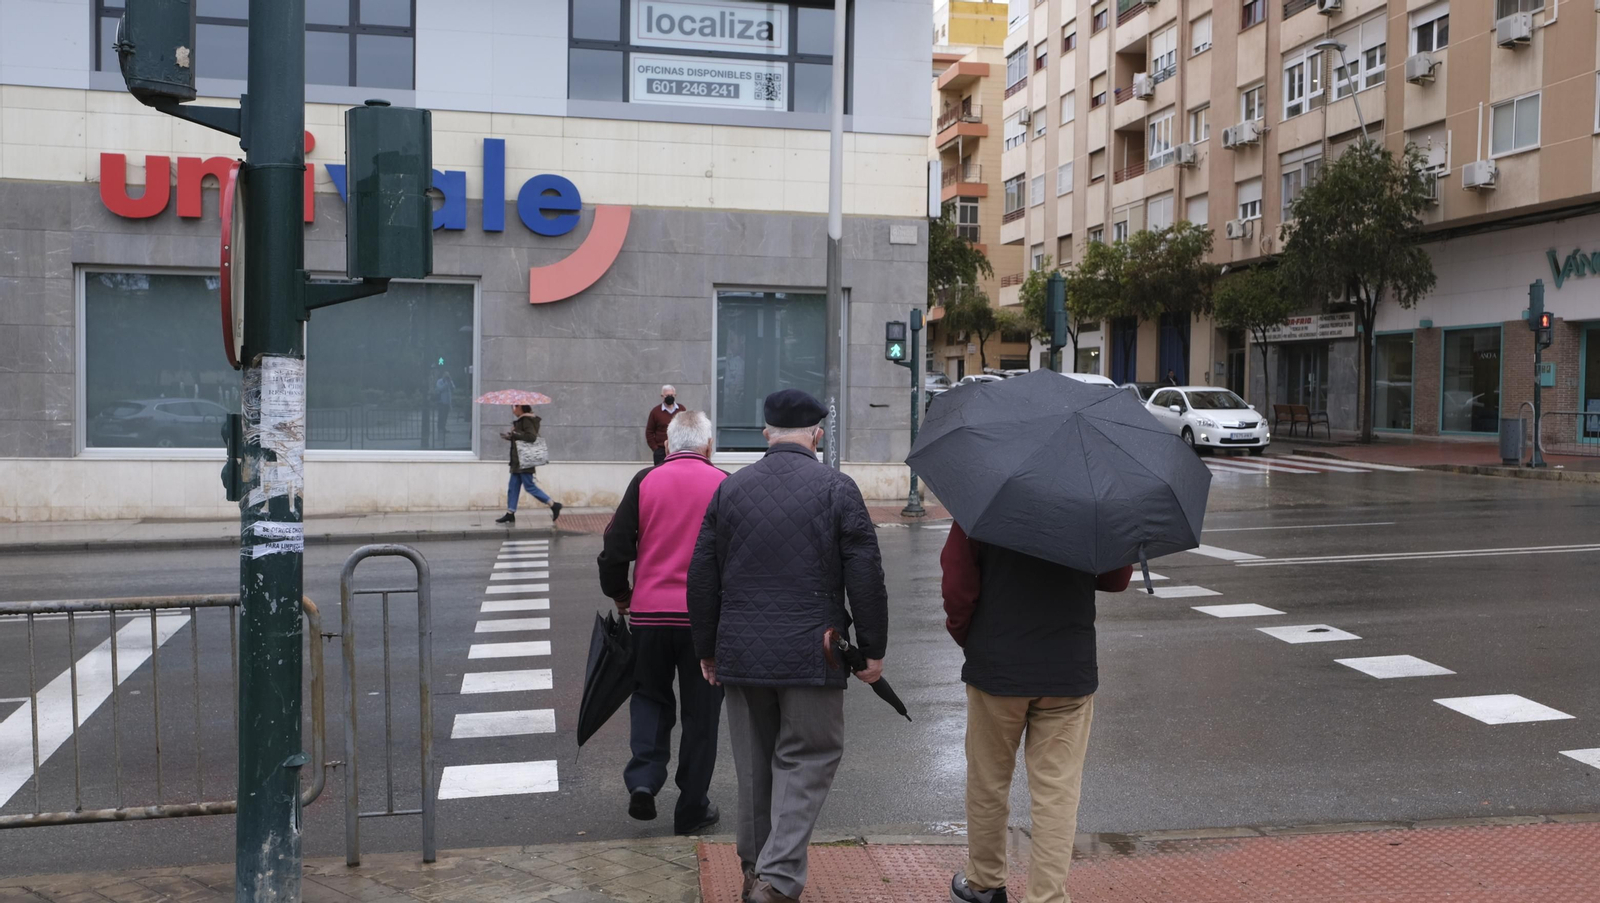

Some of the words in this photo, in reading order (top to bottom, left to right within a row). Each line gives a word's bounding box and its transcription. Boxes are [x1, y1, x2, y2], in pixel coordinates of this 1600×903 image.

[646, 6, 774, 42] localiza
[637, 65, 685, 76] OFICINAS
[687, 67, 752, 80] DISPONIBLES
[652, 80, 677, 94] 601
[682, 82, 707, 96] 246
[711, 83, 735, 97] 241
[100, 130, 582, 236] unale
